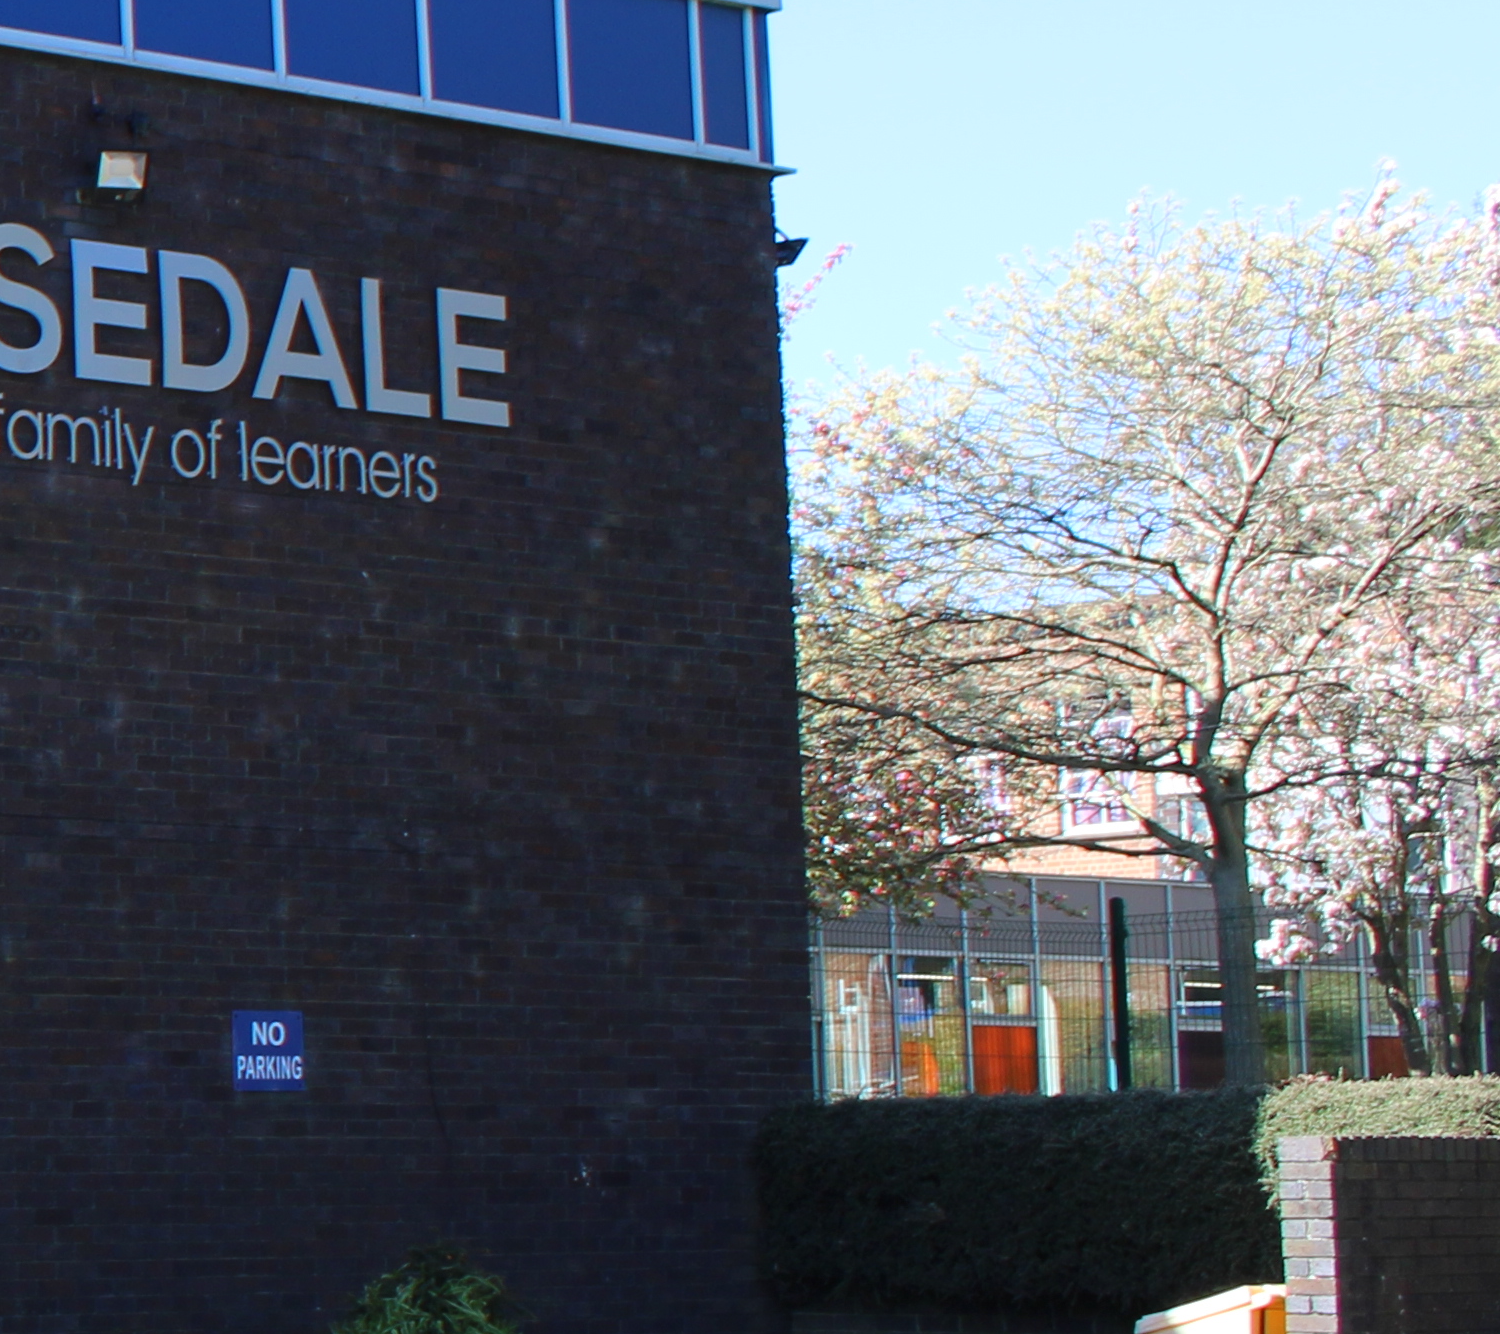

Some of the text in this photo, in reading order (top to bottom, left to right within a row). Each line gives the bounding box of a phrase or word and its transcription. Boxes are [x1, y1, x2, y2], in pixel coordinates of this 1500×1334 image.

[170, 418, 224, 480] of
[238, 421, 439, 503] learners
[251, 1021, 286, 1046] NO
[236, 1055, 304, 1080] PARKING
